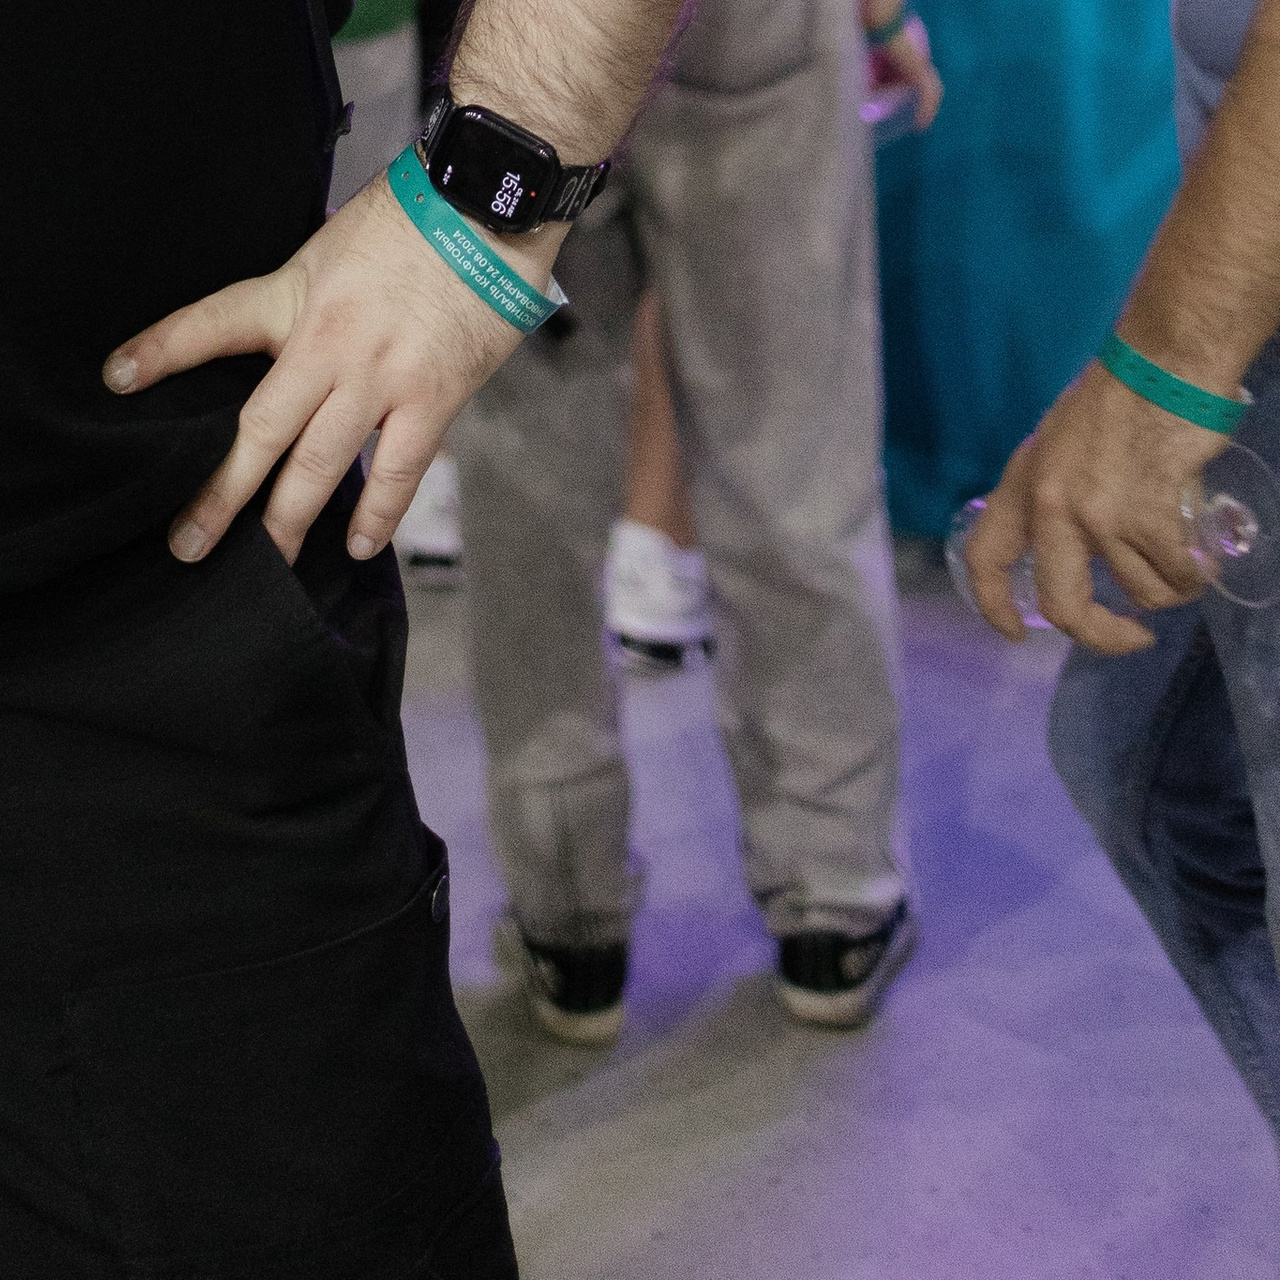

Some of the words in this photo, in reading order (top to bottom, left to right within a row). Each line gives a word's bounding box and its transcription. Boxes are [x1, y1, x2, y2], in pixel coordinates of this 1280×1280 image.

[491, 171, 521, 215] 15:56
[432, 227, 490, 288] КРАФТОВЫХ
[452, 229, 500, 279] 24.08.2024
[489, 284, 536, 327] ФЕСТИВАЛЬ
[497, 274, 548, 318] ПИВОВАРЕН
